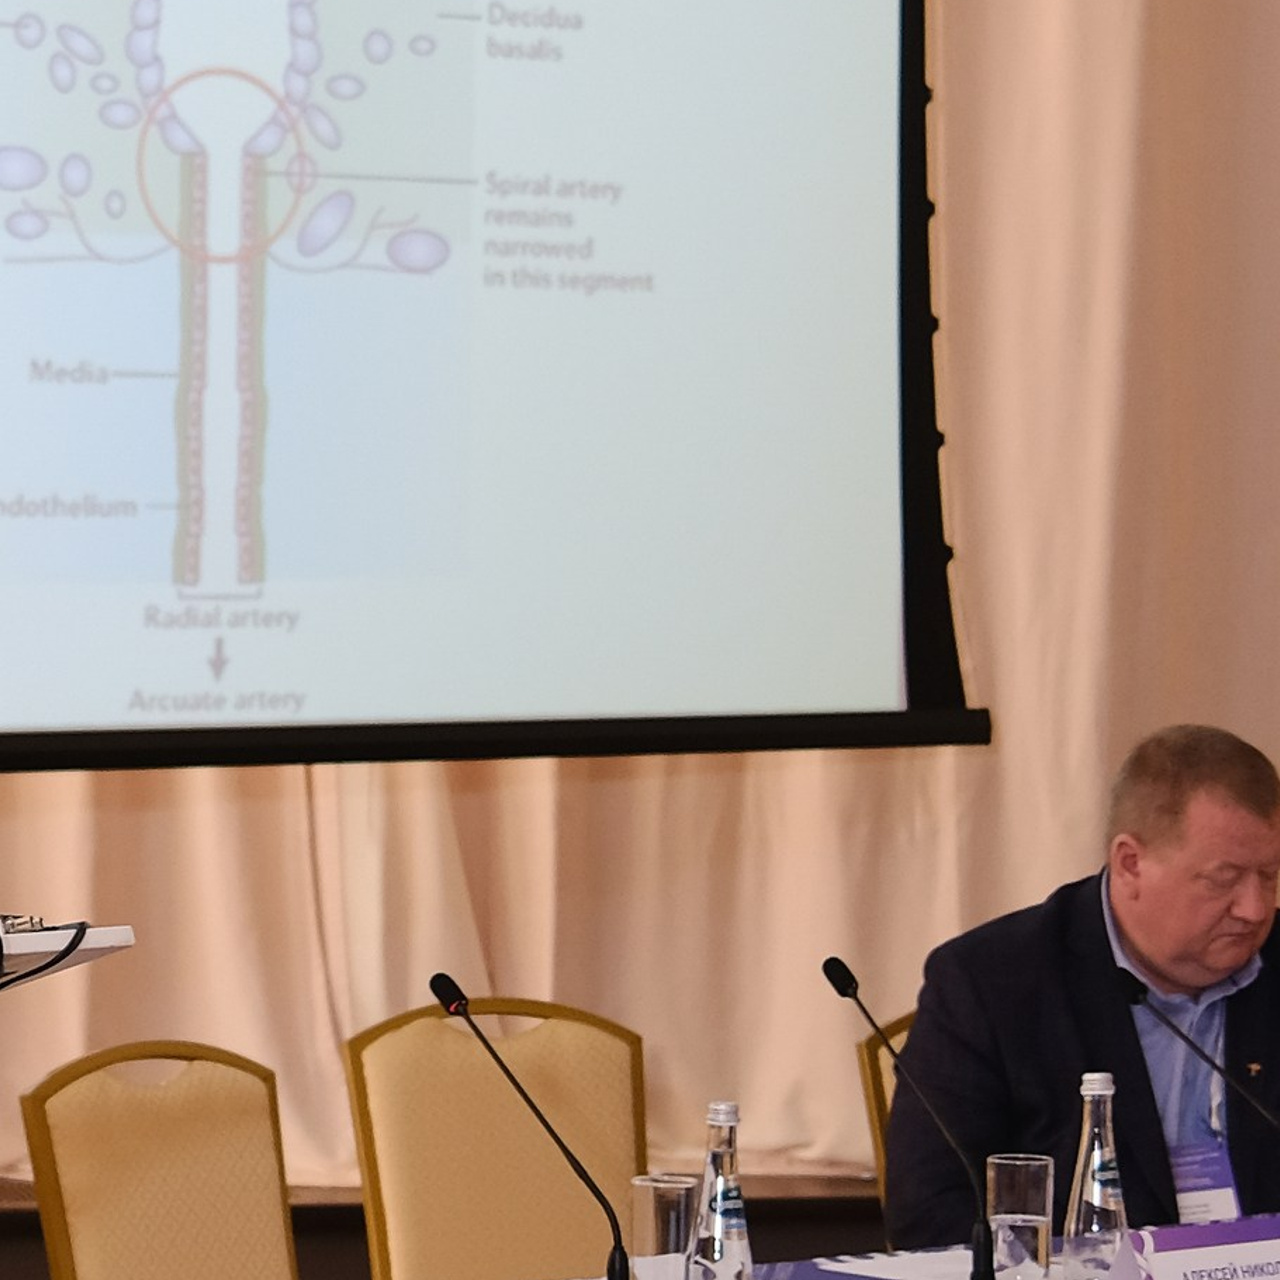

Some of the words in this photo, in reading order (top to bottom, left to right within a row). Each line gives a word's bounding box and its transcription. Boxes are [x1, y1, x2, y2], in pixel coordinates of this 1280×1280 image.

[28, 358, 109, 386] Media
[143, 604, 222, 629] Radial
[227, 609, 300, 633] artery
[128, 688, 227, 712] Arcuate
[234, 692, 306, 714] artery
[1240, 1260, 1280, 1278] НИКОЛ
